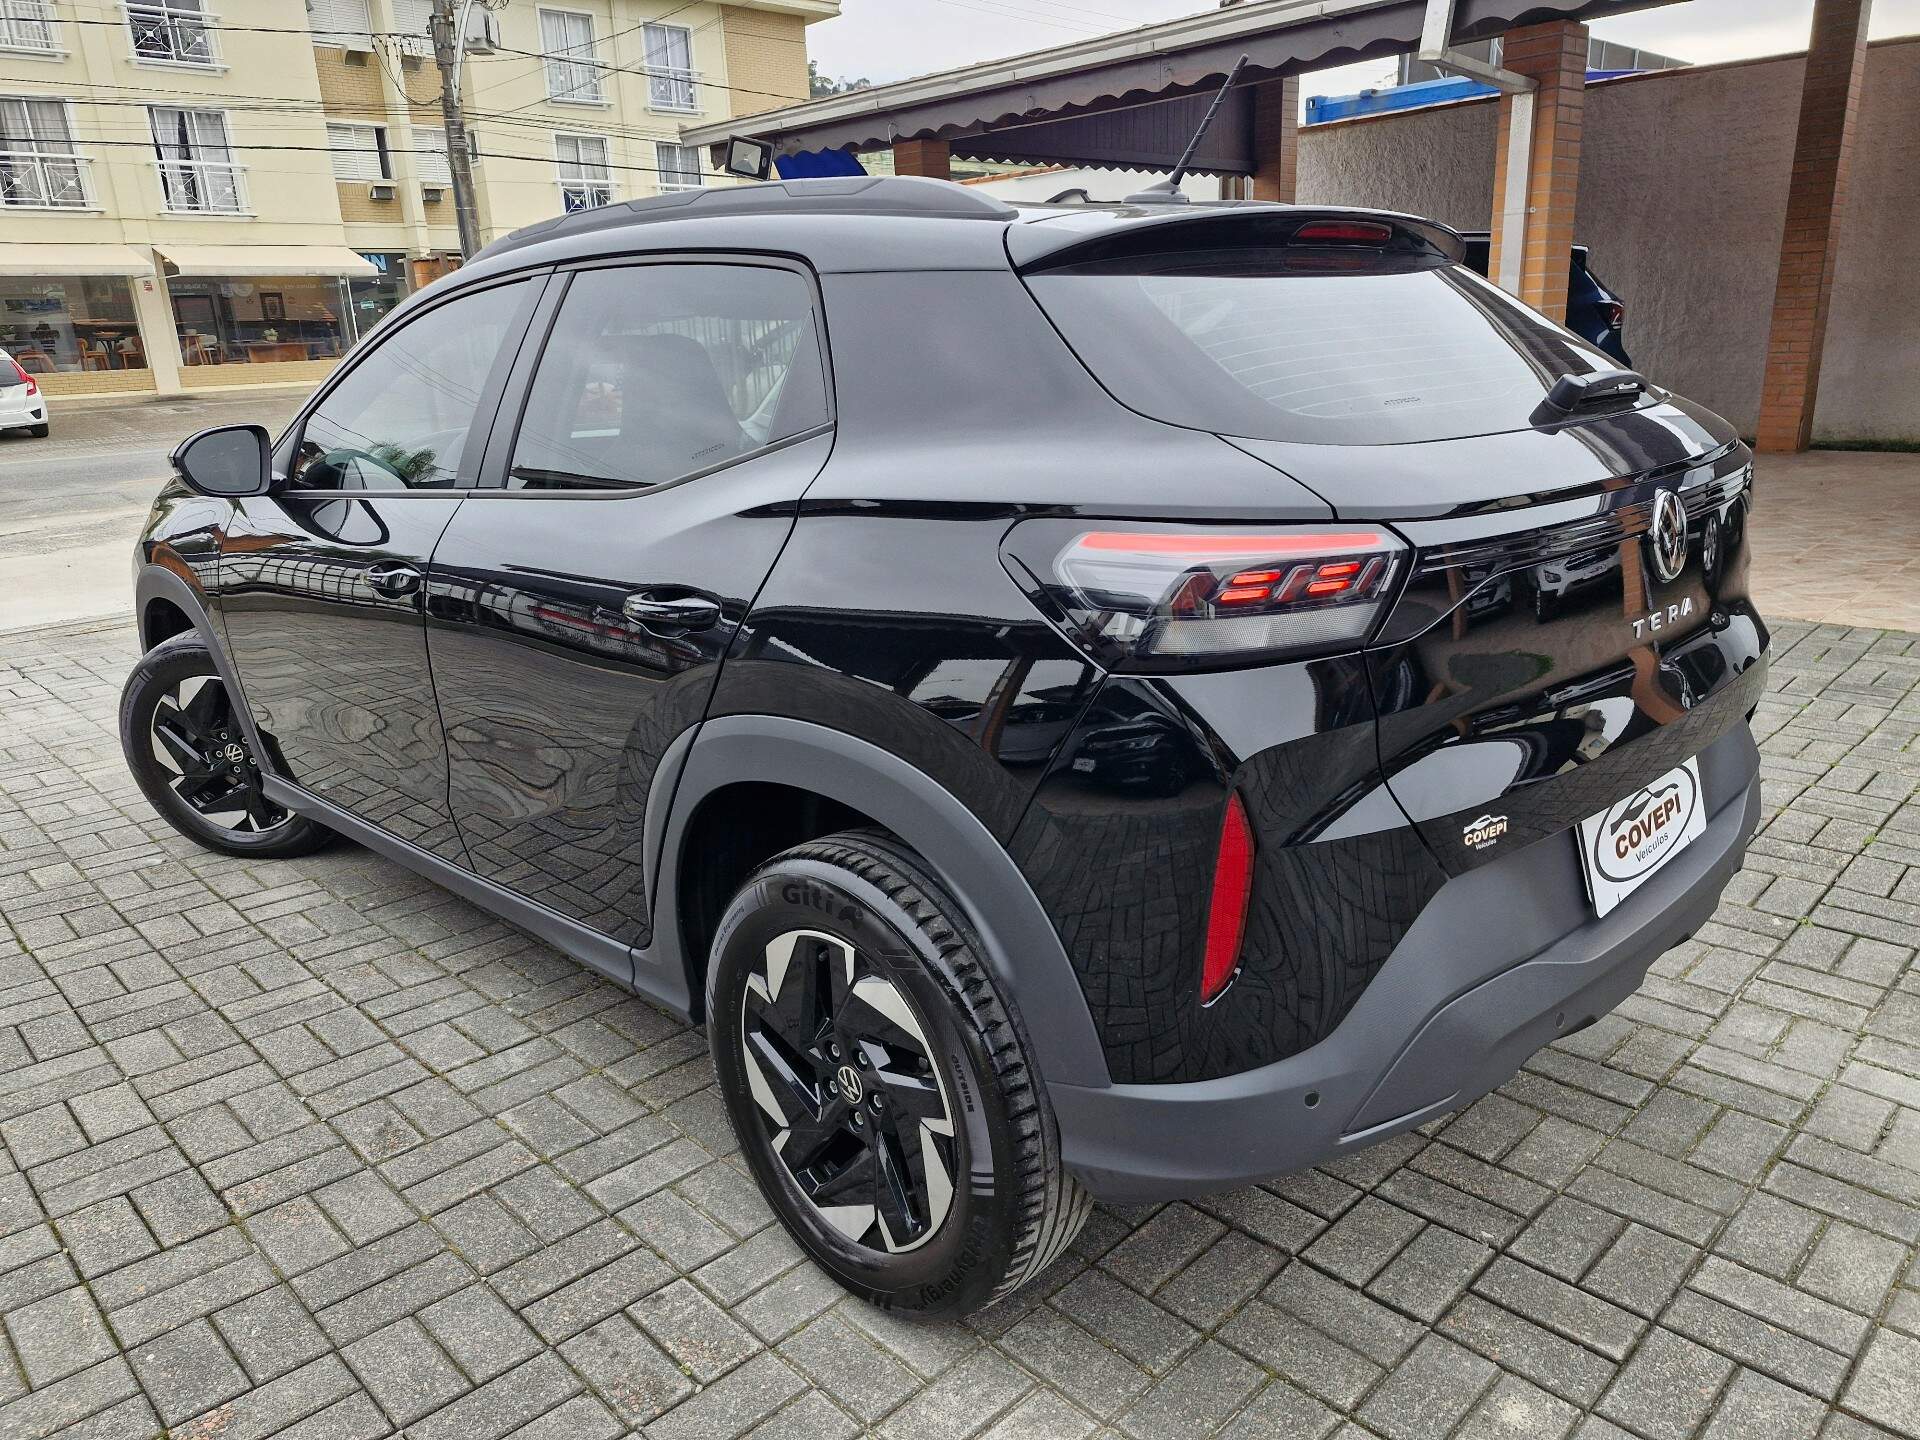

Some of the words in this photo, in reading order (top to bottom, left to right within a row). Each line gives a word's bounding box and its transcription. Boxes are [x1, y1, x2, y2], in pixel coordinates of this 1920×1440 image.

[1632, 597, 1693, 639] TERA
[1464, 820, 1508, 846] COVEPI
[1615, 792, 1682, 859] COVEPI
[782, 883, 834, 915] Giti
